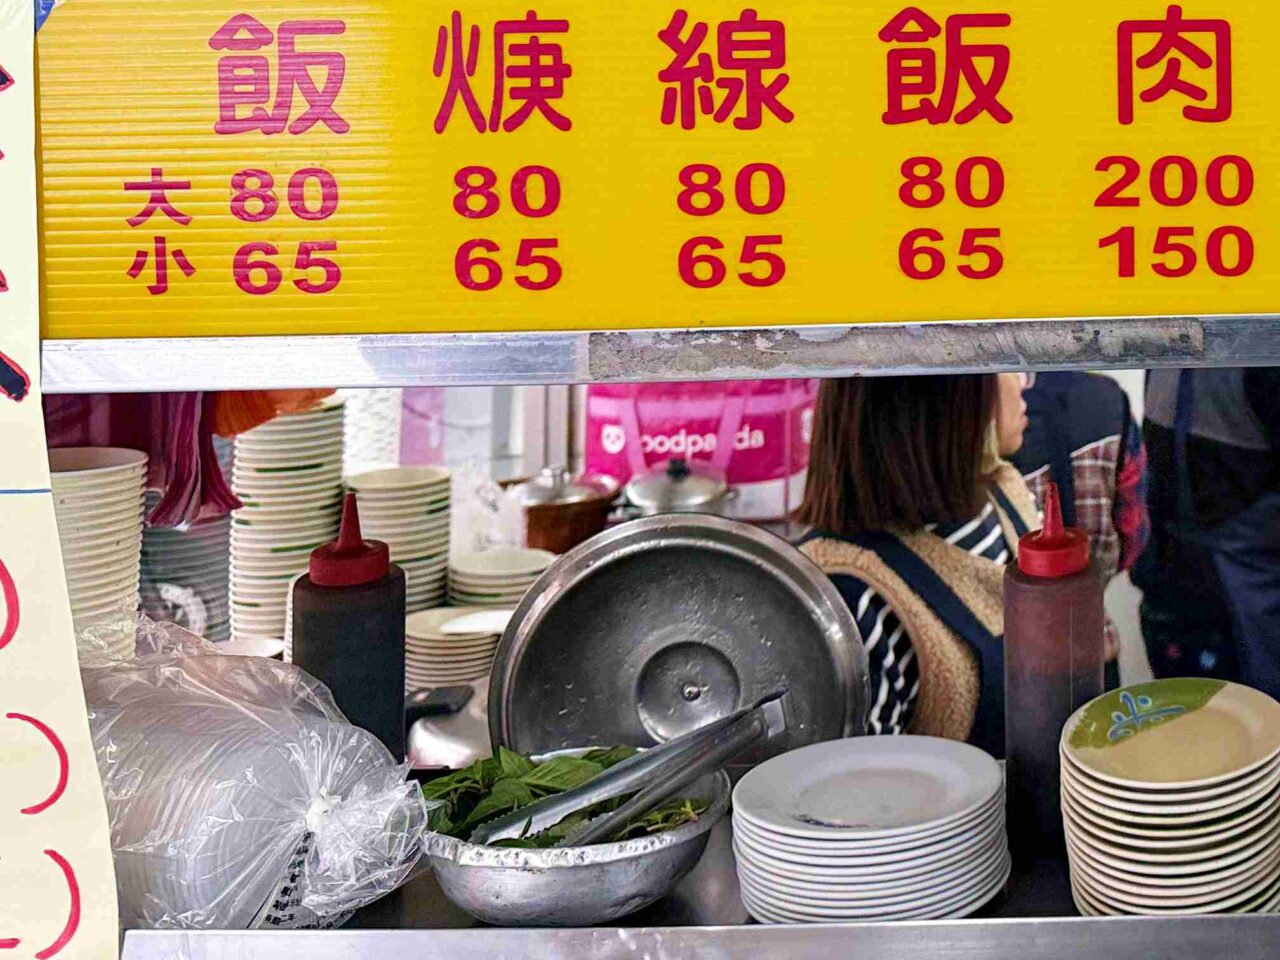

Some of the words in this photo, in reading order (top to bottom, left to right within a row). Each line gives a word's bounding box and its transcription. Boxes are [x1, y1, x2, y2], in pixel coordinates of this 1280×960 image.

[125, 168, 193, 226] 大
[230, 167, 339, 222] 80
[454, 165, 561, 219] 80
[677, 163, 785, 216] 80
[899, 156, 1004, 208] 80
[1094, 155, 1254, 207] 200
[127, 236, 196, 296] 小
[233, 241, 342, 296] 65
[455, 238, 563, 291] 65
[678, 235, 786, 288] 65
[899, 228, 1003, 280] 65
[1098, 227, 1254, 277] 150
